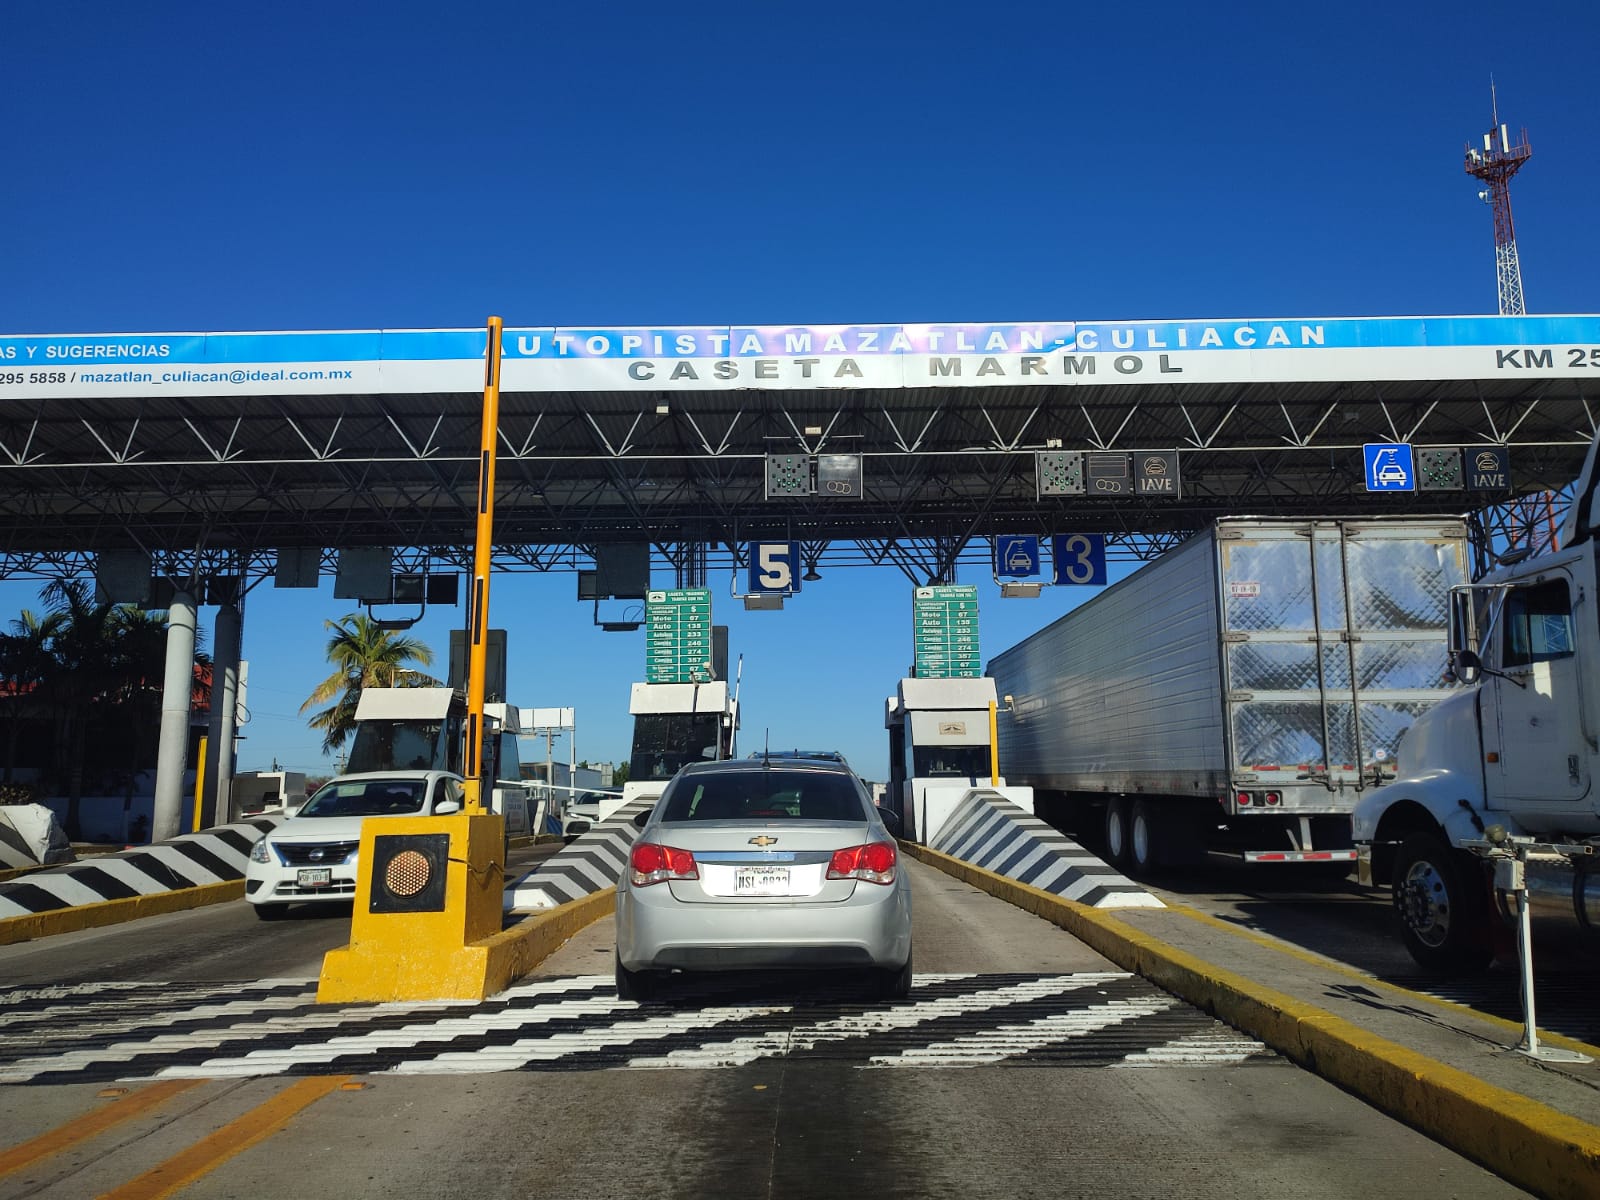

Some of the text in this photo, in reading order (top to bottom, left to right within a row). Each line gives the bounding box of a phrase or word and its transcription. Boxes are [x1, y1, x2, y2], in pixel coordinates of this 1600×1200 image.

[785, 325, 1326, 353] MAZATLAN-CULIACAN
[26, 346, 37, 359] Y
[46, 344, 170, 359] SUGERENCIAS
[1495, 349, 1553, 368] KM
[29, 372, 66, 384] 5858
[80, 369, 353, 384] mazatlan_culiacan@ideal.com.mx
[628, 354, 1183, 381] CASETA MARMOL
[1140, 478, 1173, 491] IAVE
[1473, 473, 1506, 487] IAVE
[759, 544, 790, 588] 5
[1066, 535, 1094, 584] 3
